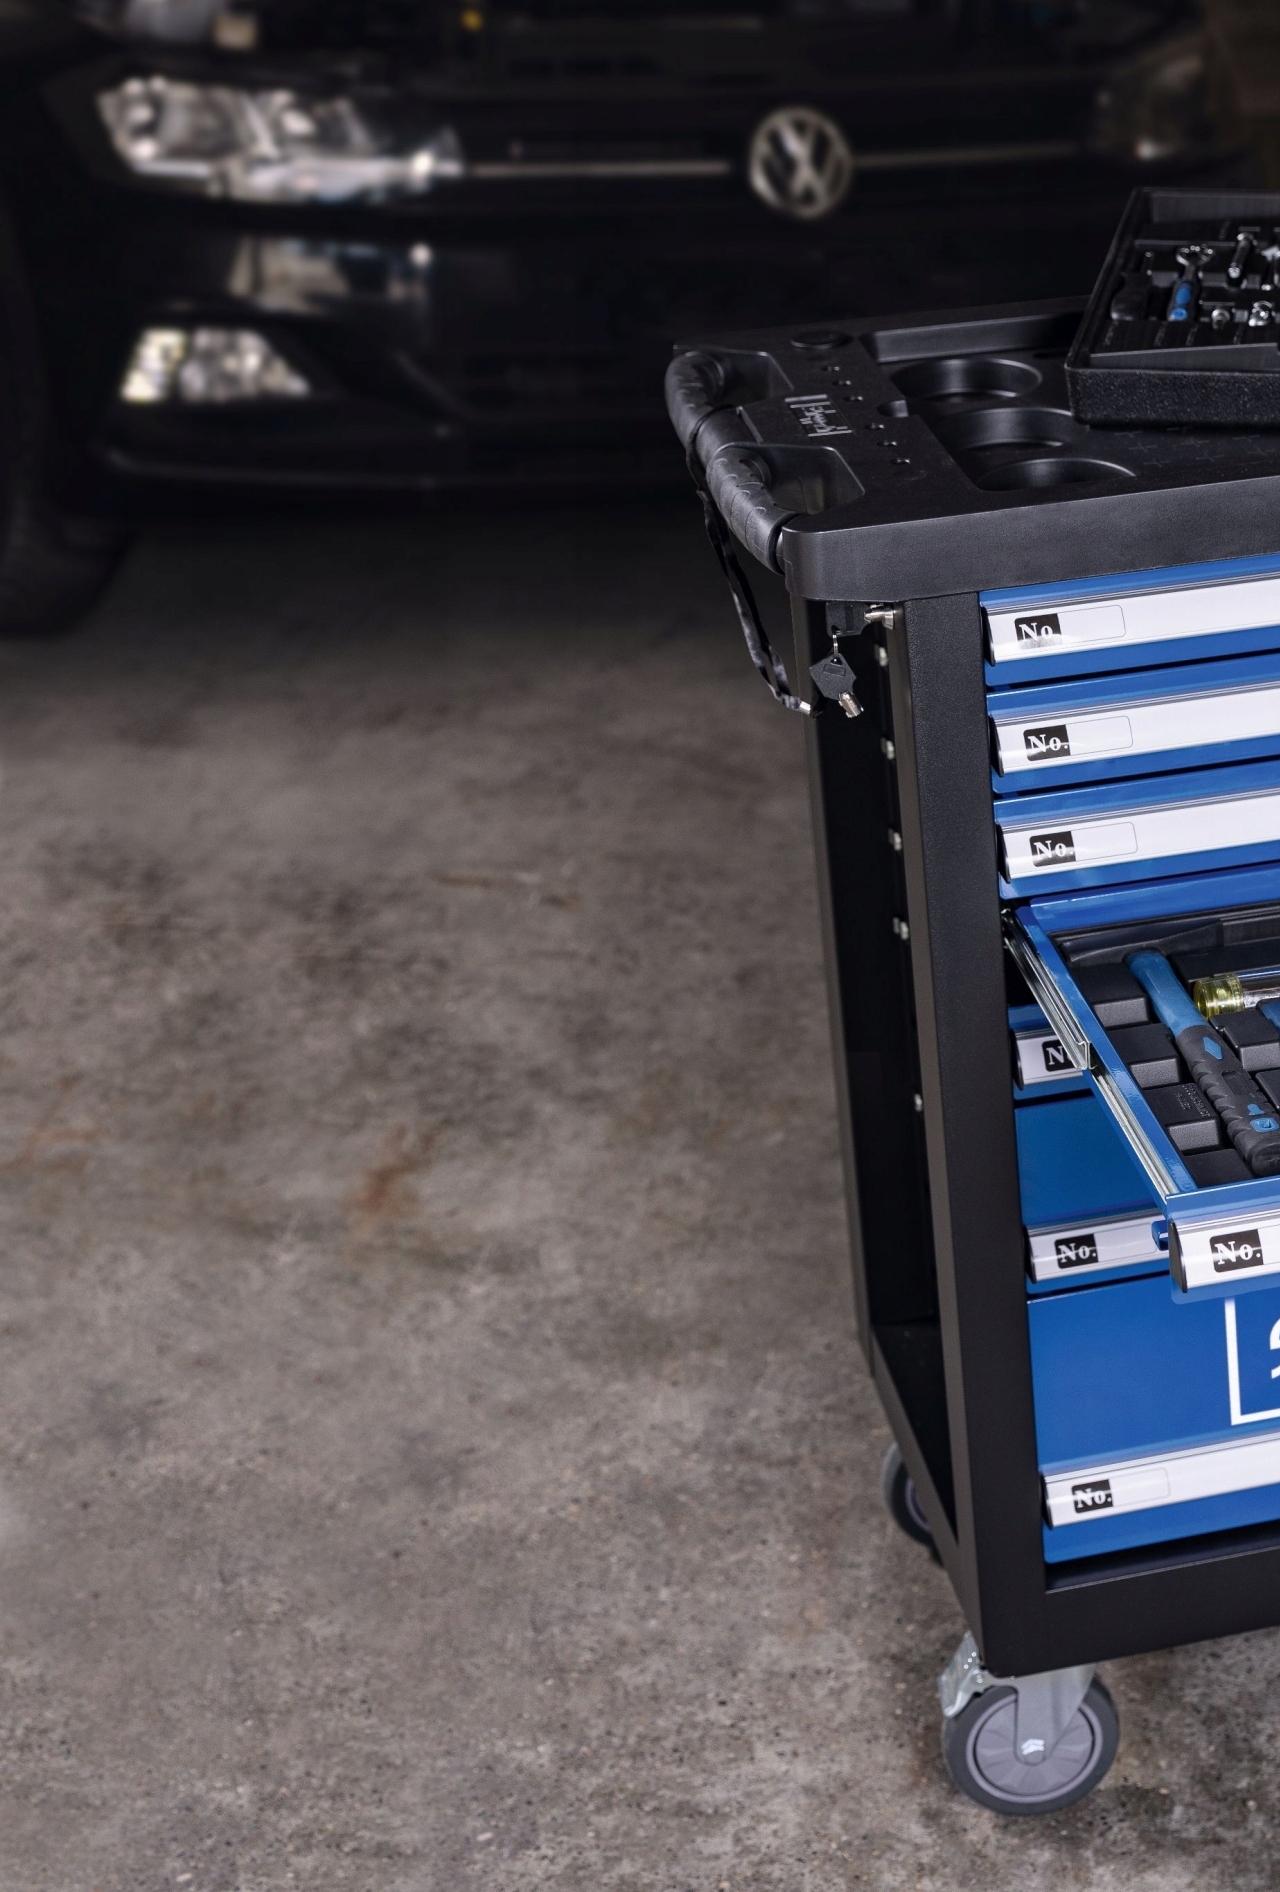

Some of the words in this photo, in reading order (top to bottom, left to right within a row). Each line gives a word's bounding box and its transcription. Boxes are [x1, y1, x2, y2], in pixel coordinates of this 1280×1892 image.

[1027, 733, 1069, 752] No.
[1033, 839, 1074, 859] No.
[1058, 1242, 1097, 1264] No.
[1213, 1240, 1261, 1265] No.
[1074, 1487, 1112, 1509] No.
